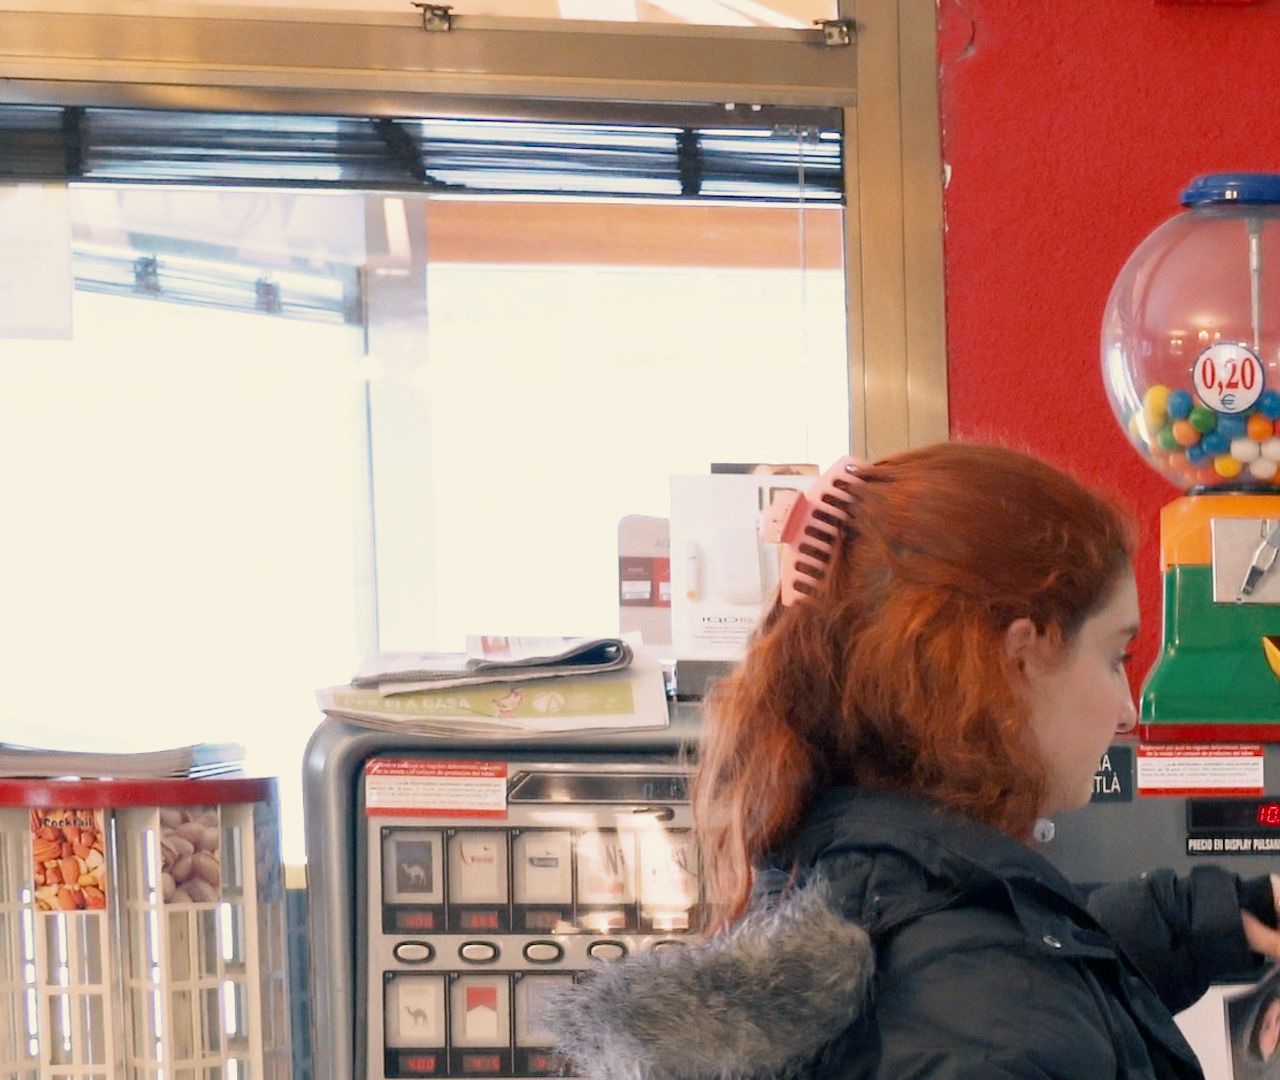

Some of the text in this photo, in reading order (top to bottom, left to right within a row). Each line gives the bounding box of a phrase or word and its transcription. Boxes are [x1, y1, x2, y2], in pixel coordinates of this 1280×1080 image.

[1202, 358, 1255, 396] 0,20
[1092, 771, 1122, 794] TLÀ
[41, 816, 94, 829] Cocktail
[1188, 838, 1212, 851] PRECIO
[1213, 838, 1224, 851] EN
[1224, 838, 1252, 851] DISPLAY
